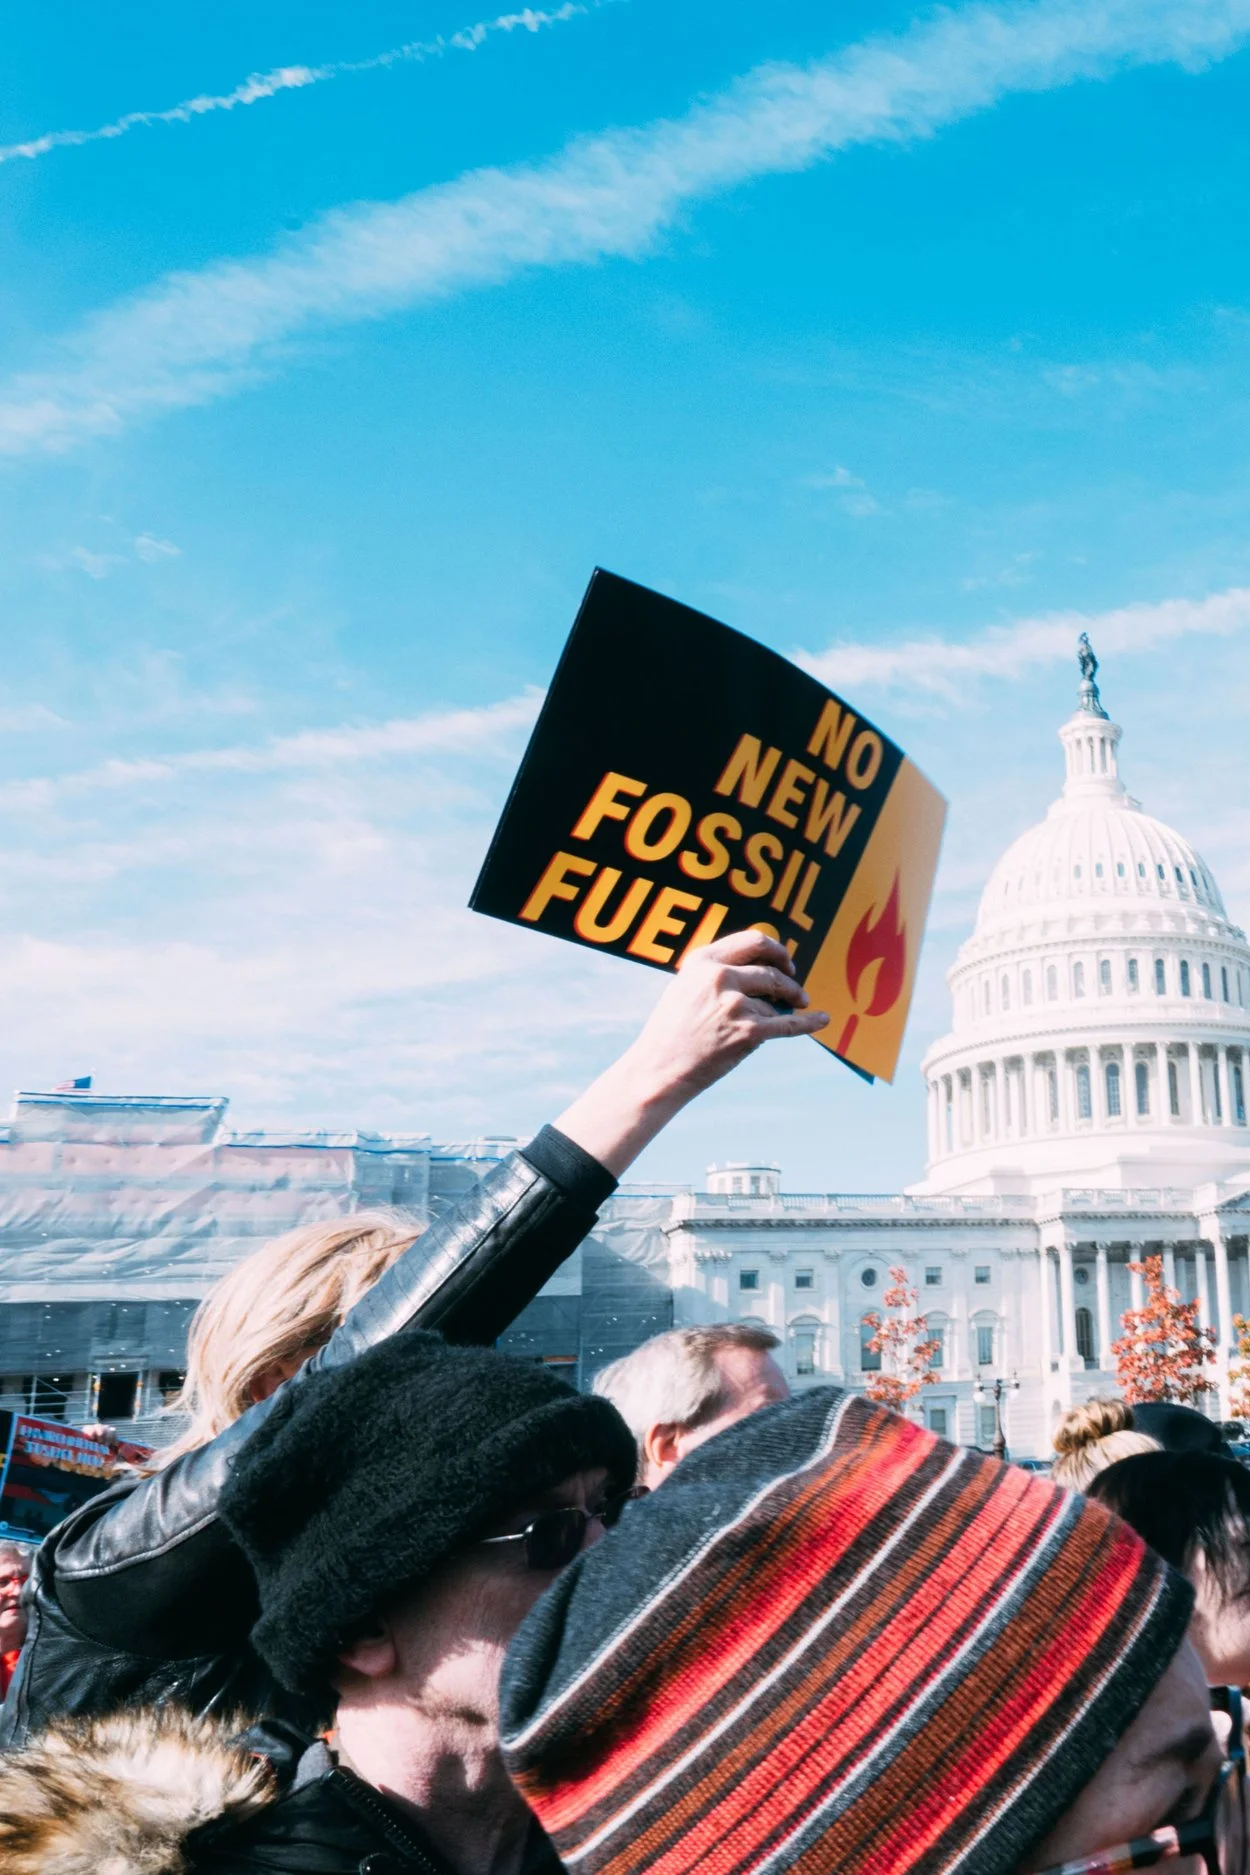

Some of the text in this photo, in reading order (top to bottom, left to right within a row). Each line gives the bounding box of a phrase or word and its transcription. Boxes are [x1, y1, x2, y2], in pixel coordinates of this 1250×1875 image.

[713, 733, 862, 858] NEW
[807, 698, 883, 790] NO
[570, 771, 821, 932] FOSSIL
